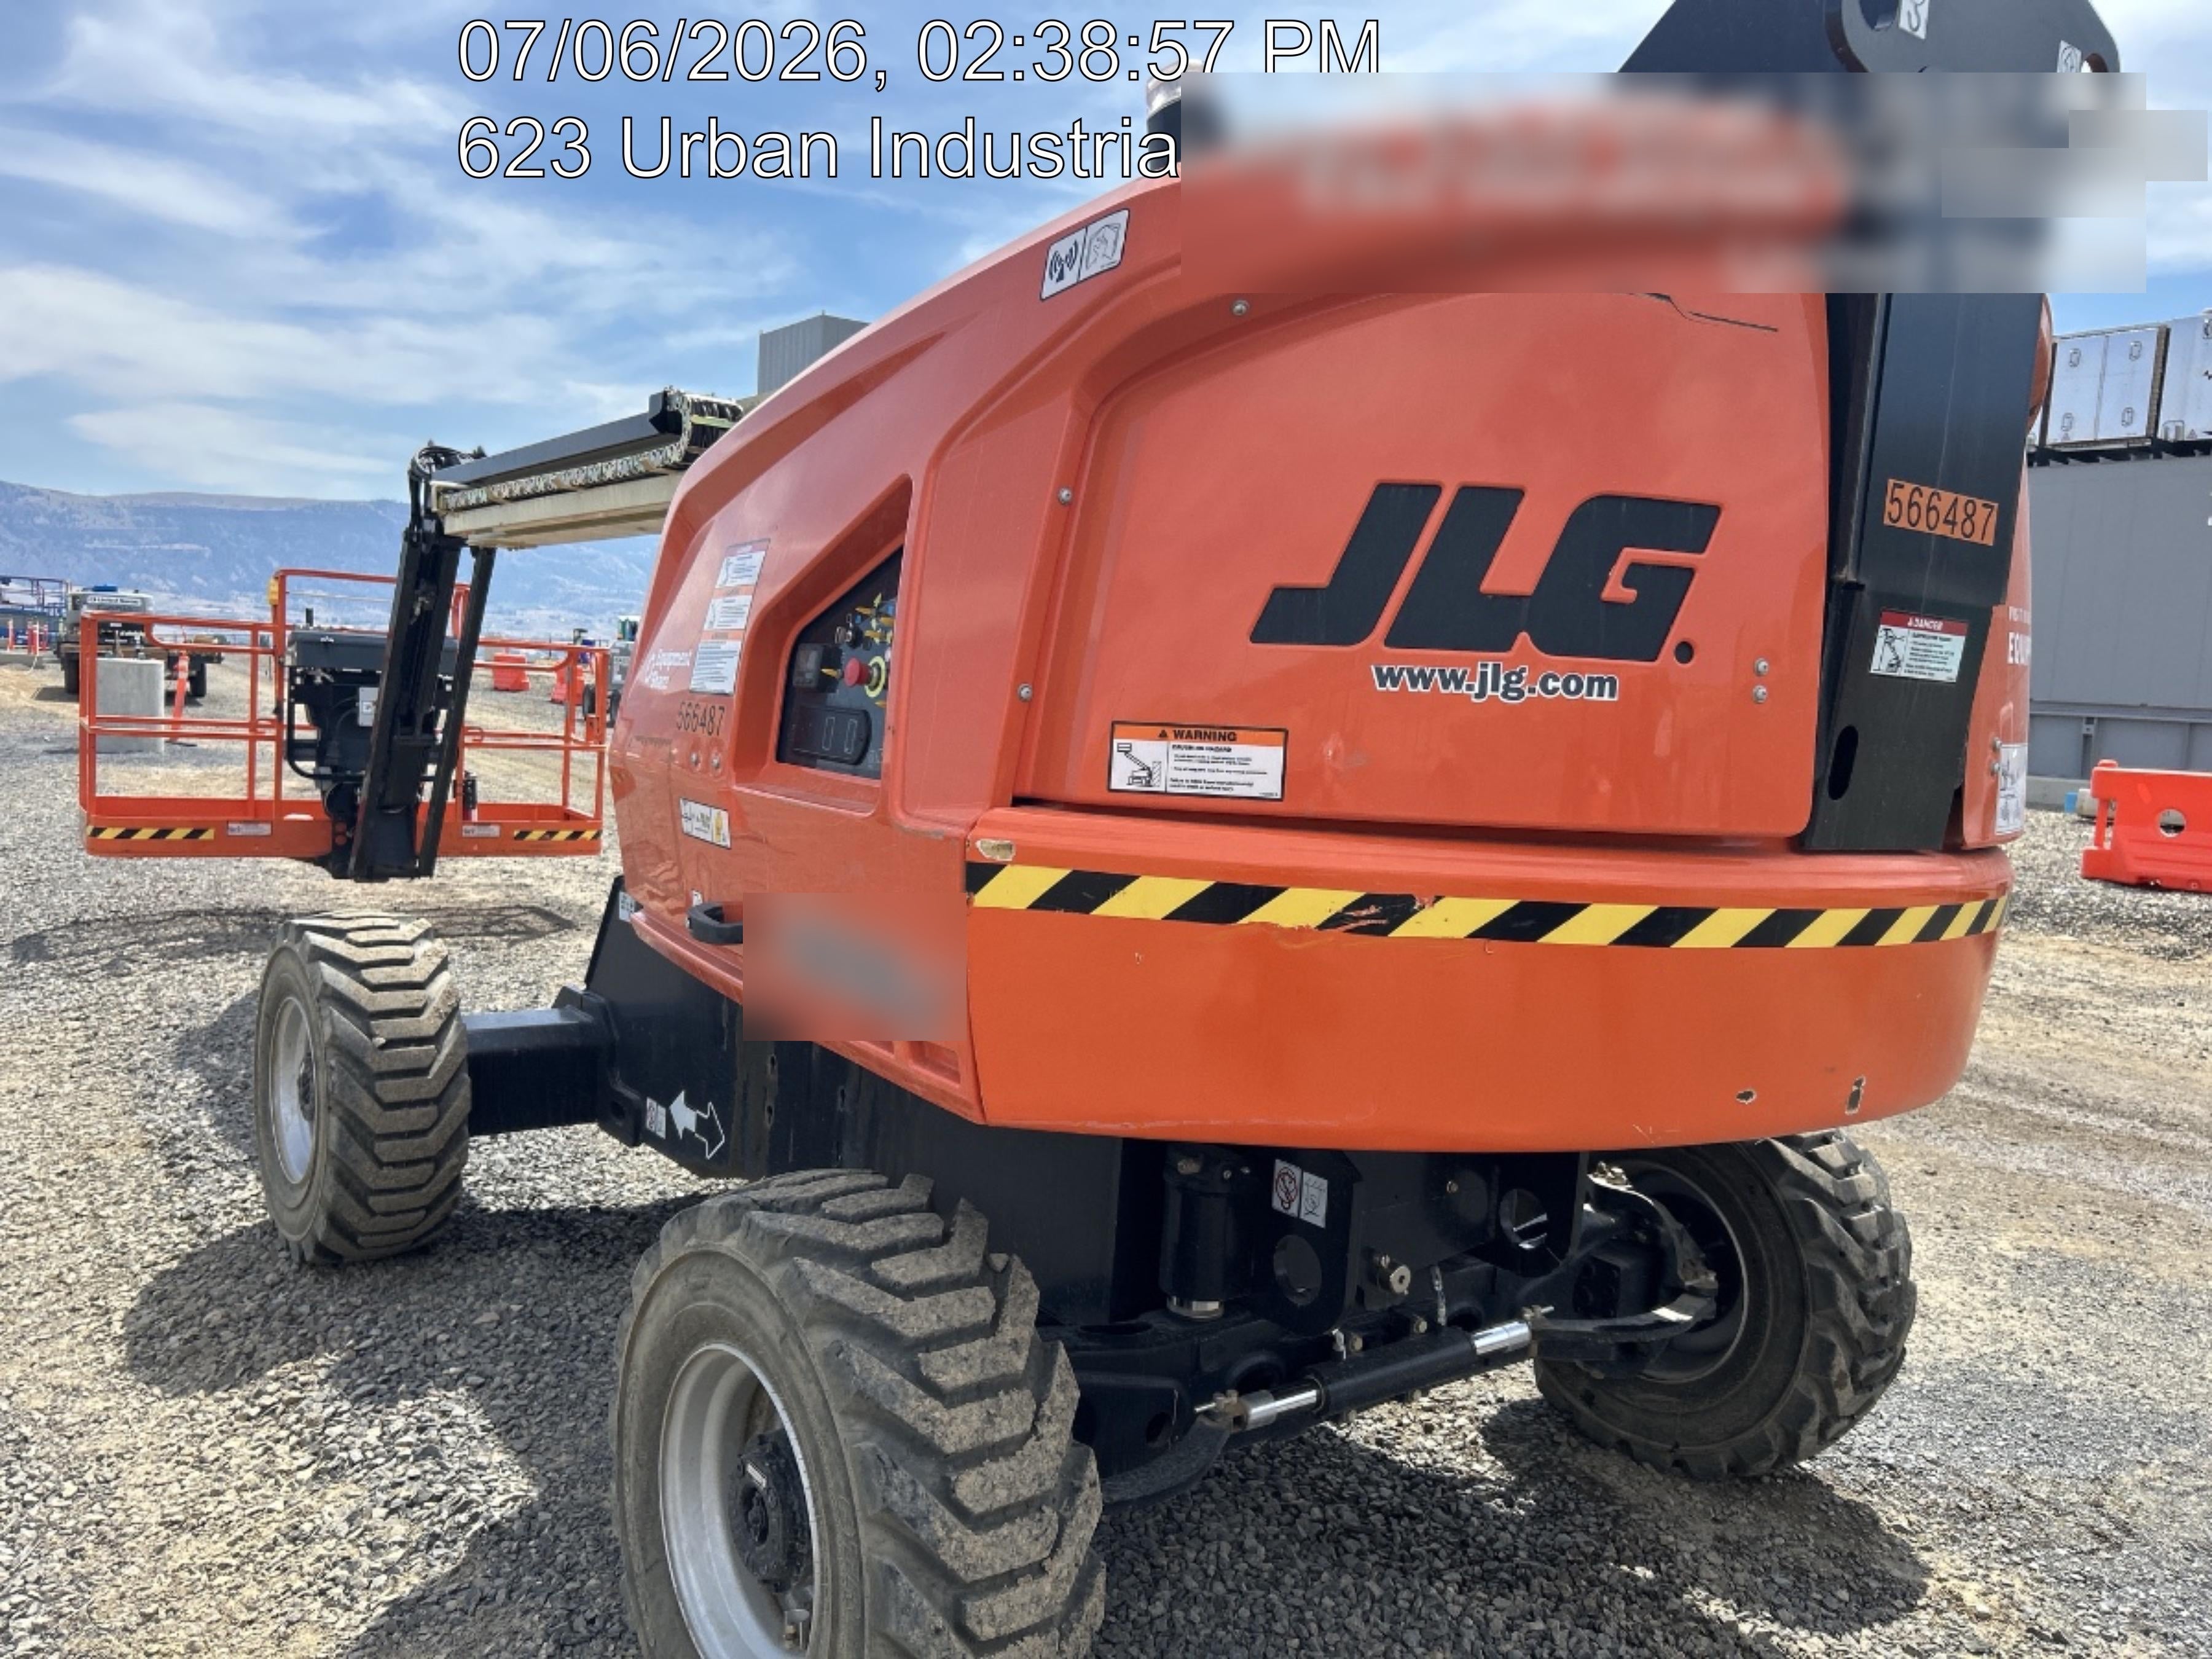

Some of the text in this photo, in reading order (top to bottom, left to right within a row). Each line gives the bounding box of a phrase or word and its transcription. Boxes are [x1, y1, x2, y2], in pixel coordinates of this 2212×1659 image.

[1888, 482, 1994, 541] 566487
[1250, 482, 1722, 663] JLG
[1373, 662, 1618, 702] www.jlg.com
[677, 700, 725, 736] 566487
[1172, 729, 1237, 742] WARNING
